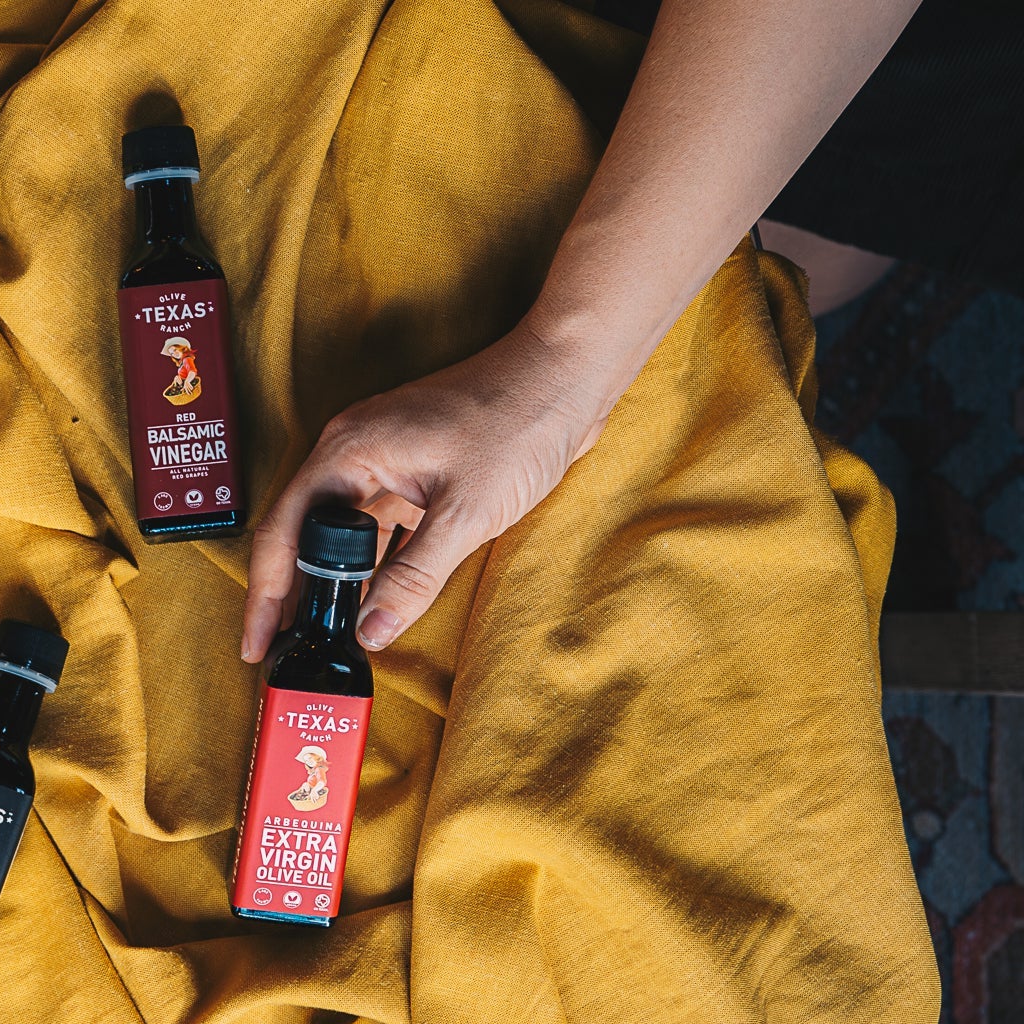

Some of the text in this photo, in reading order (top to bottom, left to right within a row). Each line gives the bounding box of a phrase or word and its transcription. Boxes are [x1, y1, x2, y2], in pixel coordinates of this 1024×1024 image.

[159, 293, 186, 303] OLIVE
[142, 302, 206, 323] TEXAS
[160, 322, 191, 332] RANCH
[176, 413, 196, 422] RED
[147, 423, 225, 444] BALSAMIC
[150, 440, 227, 466] VINEGAR
[306, 704, 334, 713] OLIVE
[287, 712, 350, 733] TEXAS
[300, 732, 331, 742] RANCH
[264, 816, 341, 831] ARBEQUINA
[261, 828, 337, 853] EXTRA
[260, 848, 336, 872] VIRGIN
[256, 866, 332, 886] OLIVE OIL
